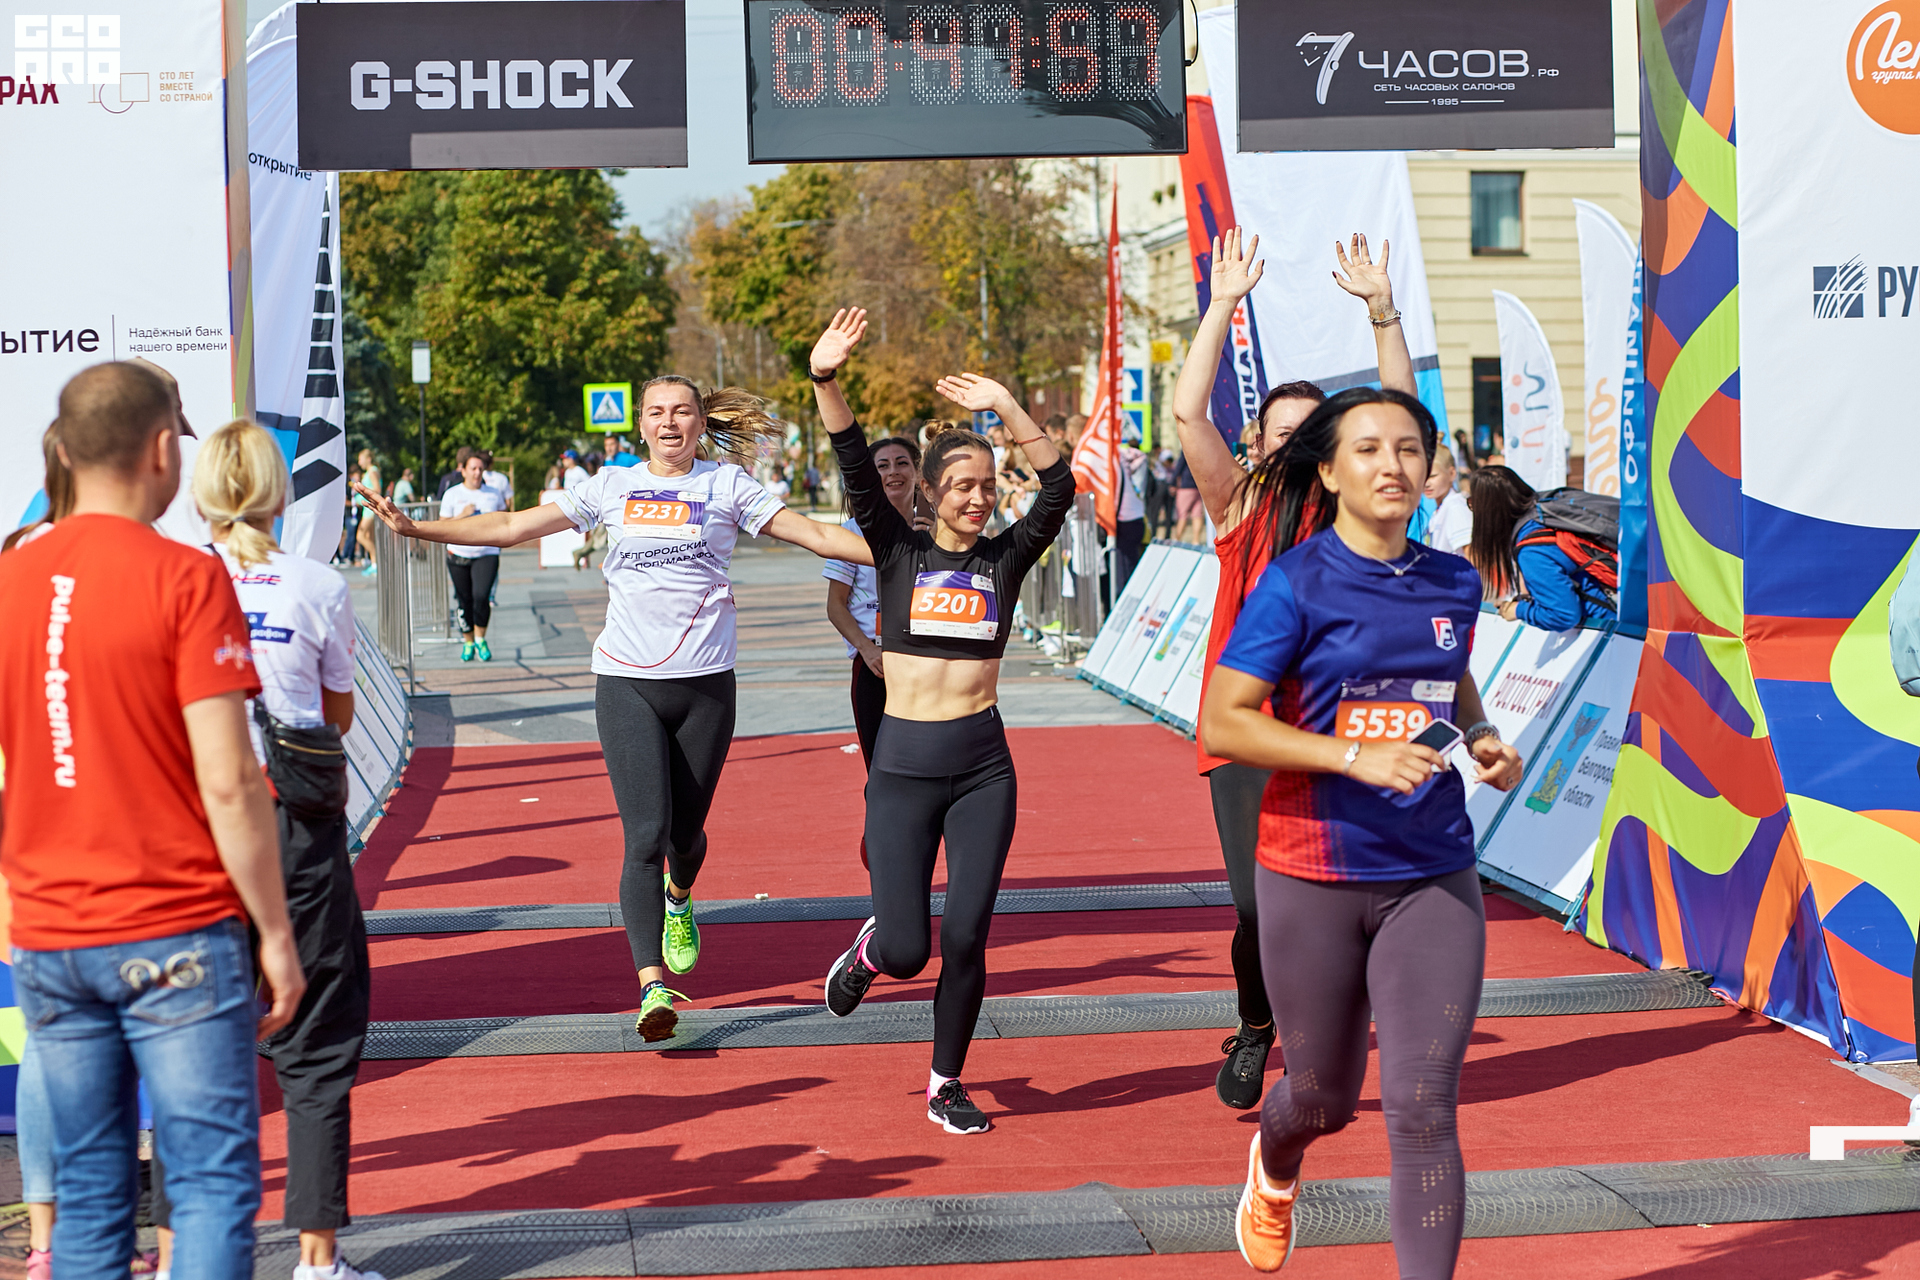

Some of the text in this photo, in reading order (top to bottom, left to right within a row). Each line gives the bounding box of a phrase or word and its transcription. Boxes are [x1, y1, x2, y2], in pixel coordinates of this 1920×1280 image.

[159, 71, 195, 80] СТО ЛЕТ
[1871, 71, 1914, 85] группа
[159, 82, 194, 91] ВМЕСТЕ
[350, 59, 634, 110] G-SHOCK
[1373, 82, 1516, 91] СЕТЬ ЧАСОВЫХ САЛОНОВ
[159, 91, 213, 102] СО СТРАНОЙ
[1431, 98, 1459, 106] 1995
[248, 152, 312, 181] открытие
[129, 326, 223, 339] Надёжный банк
[0, 328, 100, 354] ытие
[129, 342, 228, 353] нашего времени
[629, 503, 685, 520] 5231
[918, 592, 980, 616] 5201
[45, 574, 76, 788] pulse-team.ru
[1344, 708, 1427, 739] 5539
[1563, 785, 1596, 810] области
